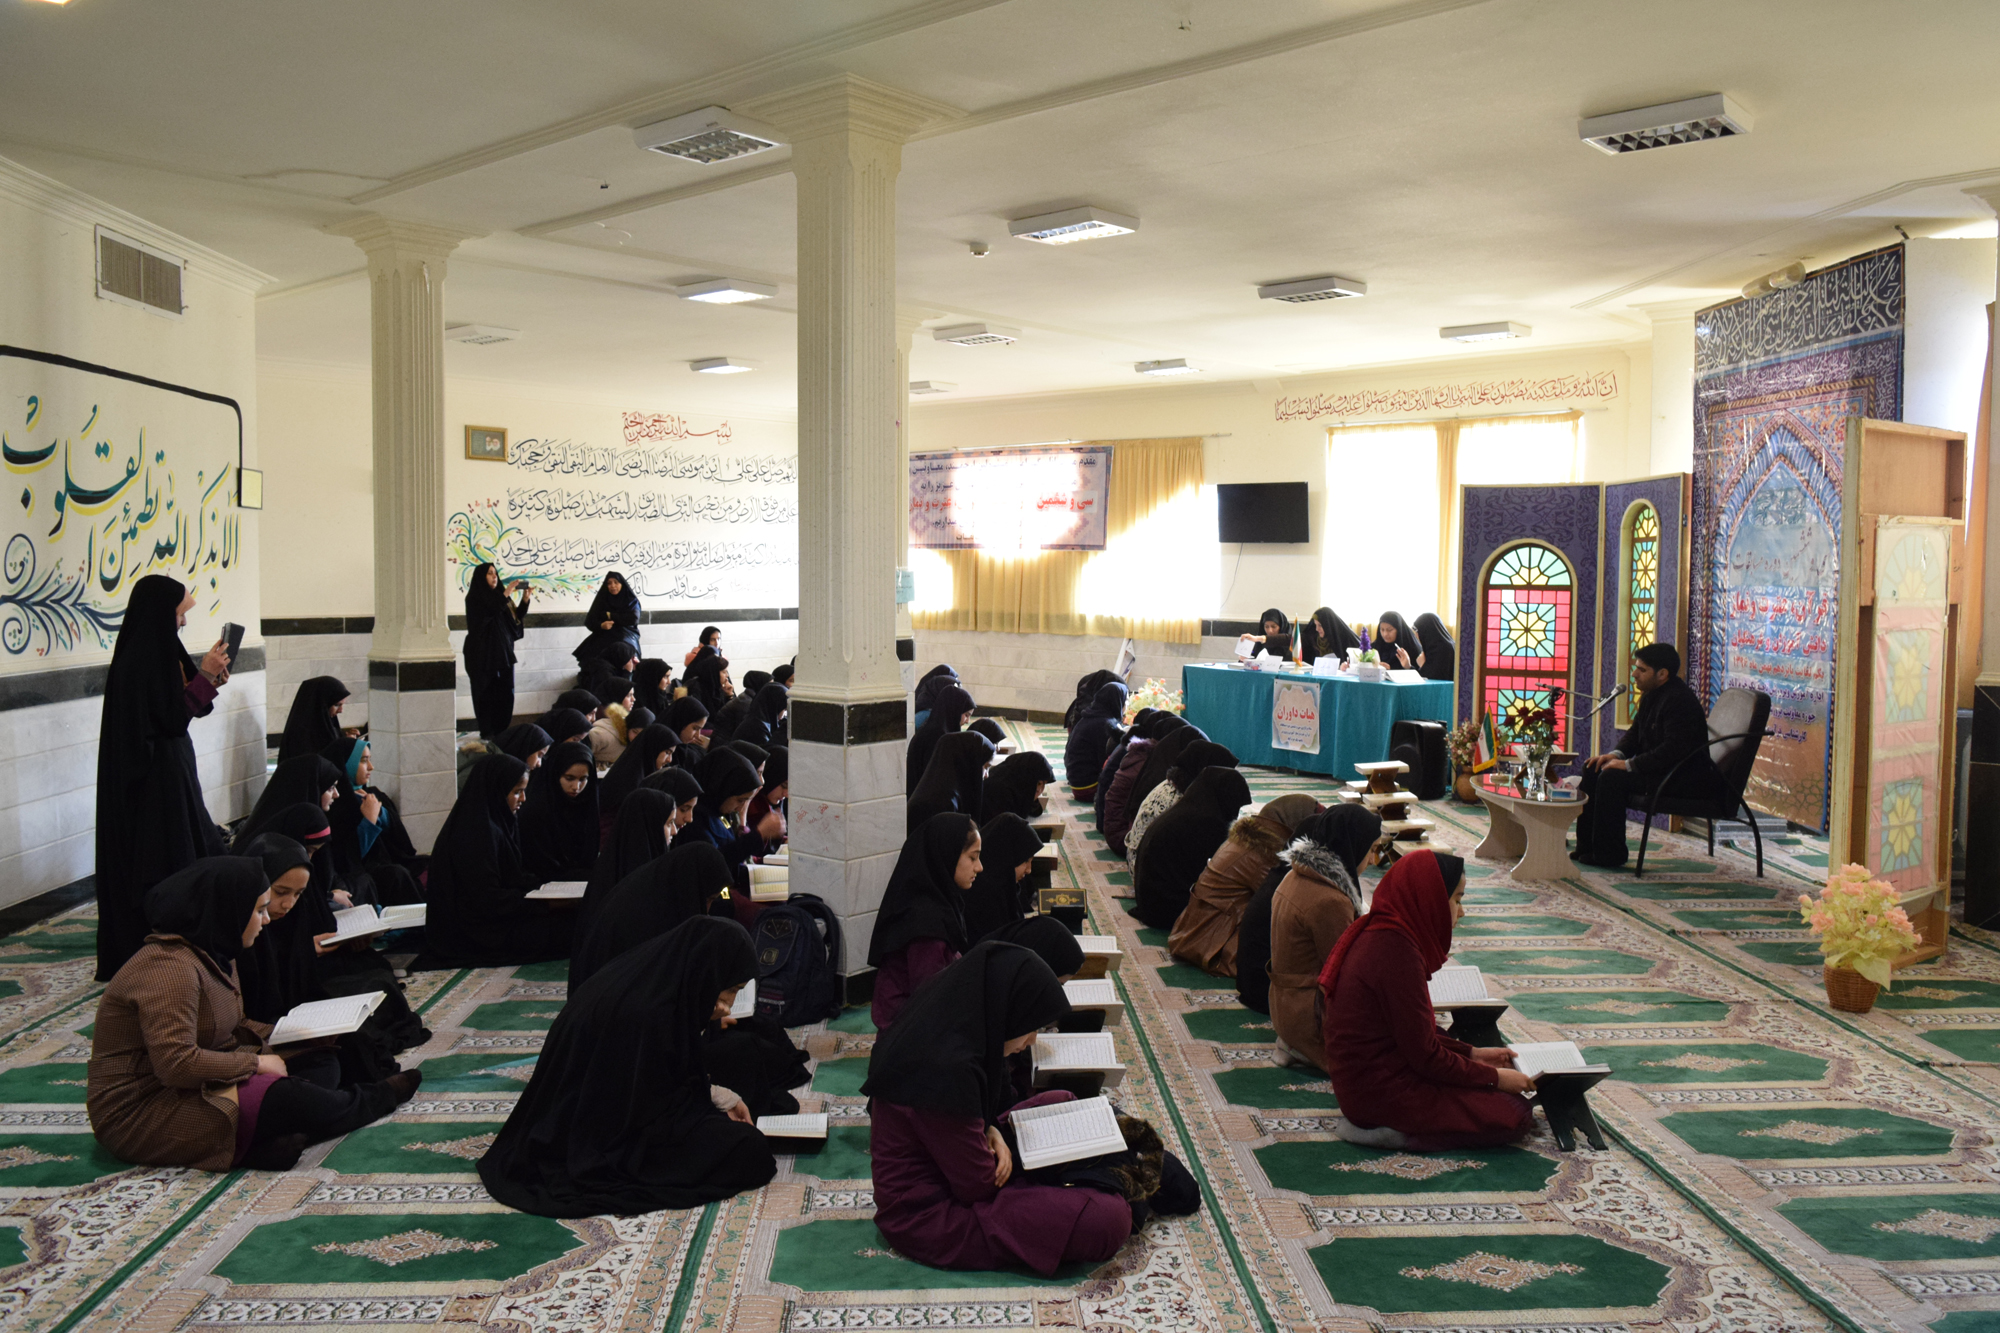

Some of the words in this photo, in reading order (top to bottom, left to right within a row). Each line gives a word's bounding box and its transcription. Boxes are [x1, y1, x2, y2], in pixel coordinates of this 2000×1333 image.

[680, 420, 732, 446] بسم
[935, 480, 954, 492] عزیز
[931, 497, 952, 512] عترت
[1069, 499, 1076, 510] و
[1077, 498, 1094, 510] سی
[1277, 705, 1299, 721] داوران
